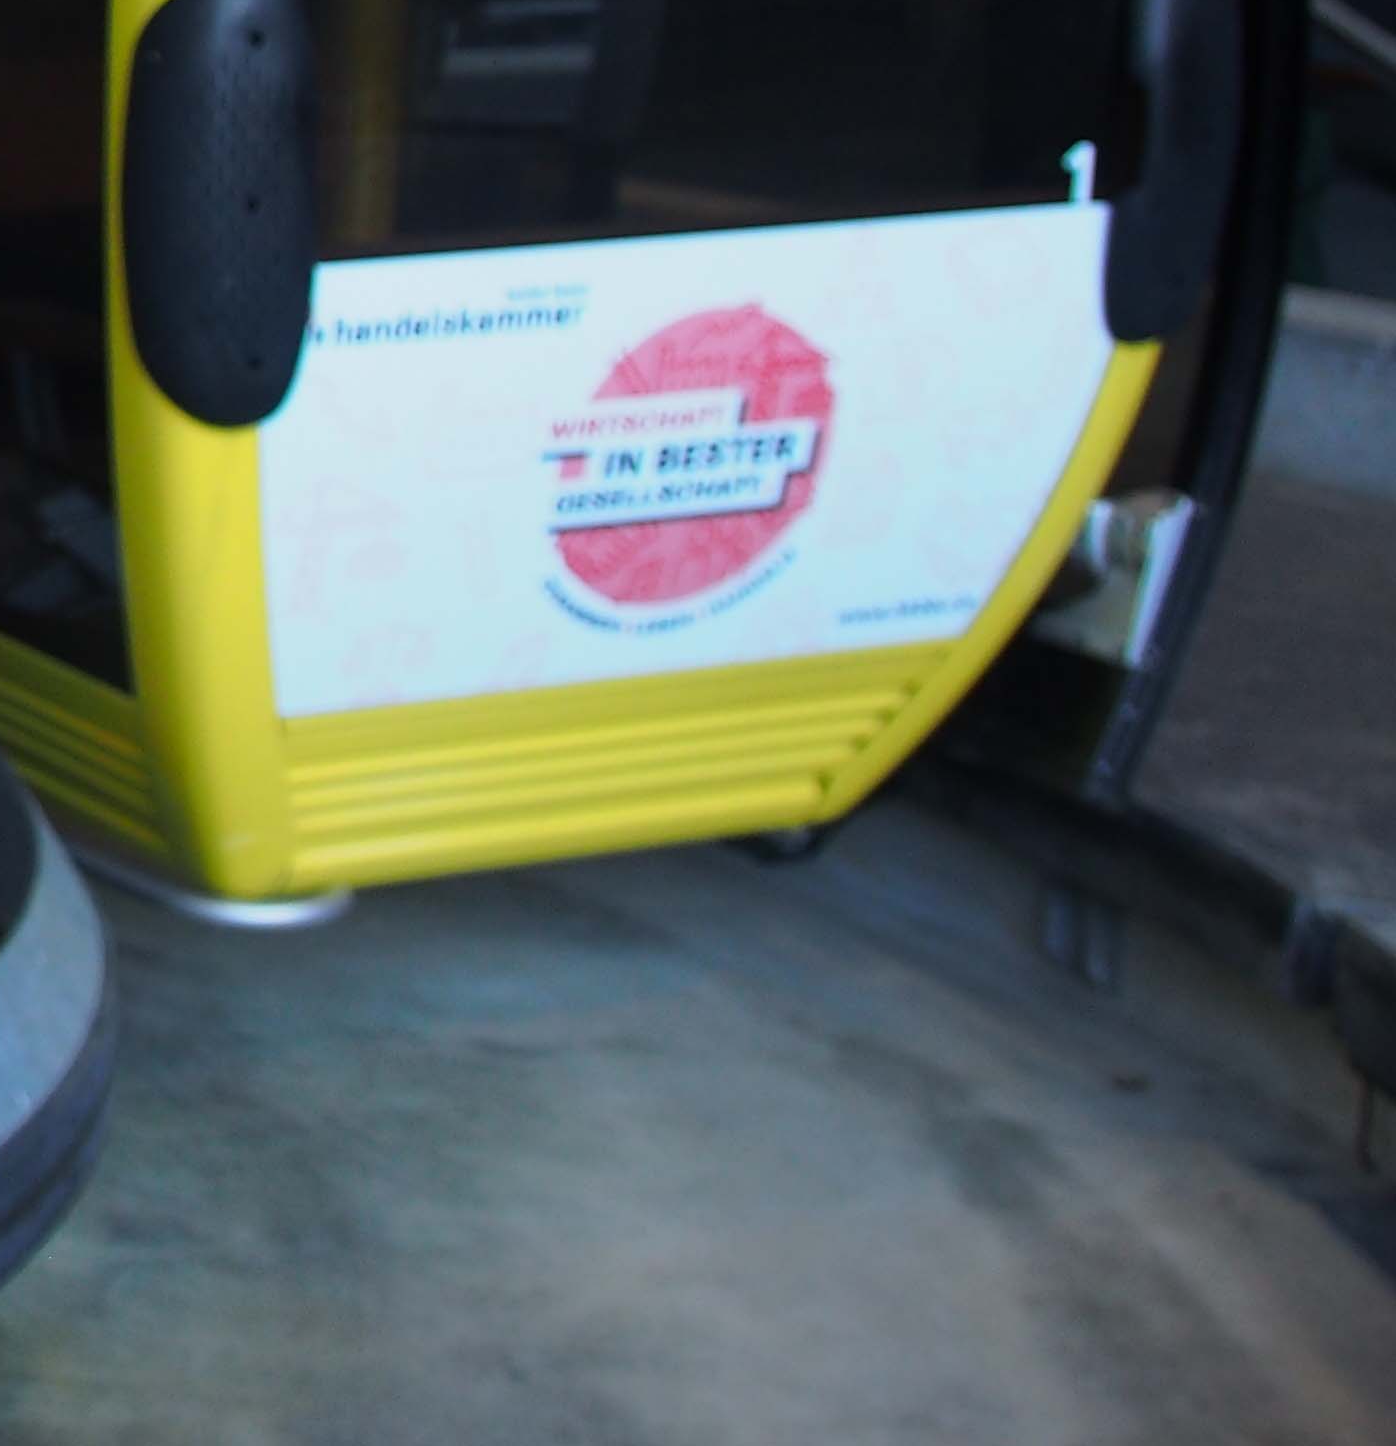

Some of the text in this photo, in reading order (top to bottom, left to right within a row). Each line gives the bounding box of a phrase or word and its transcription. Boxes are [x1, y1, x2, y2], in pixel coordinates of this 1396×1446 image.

[334, 305, 585, 345] handelskammer
[603, 431, 798, 479] IN BESTER
